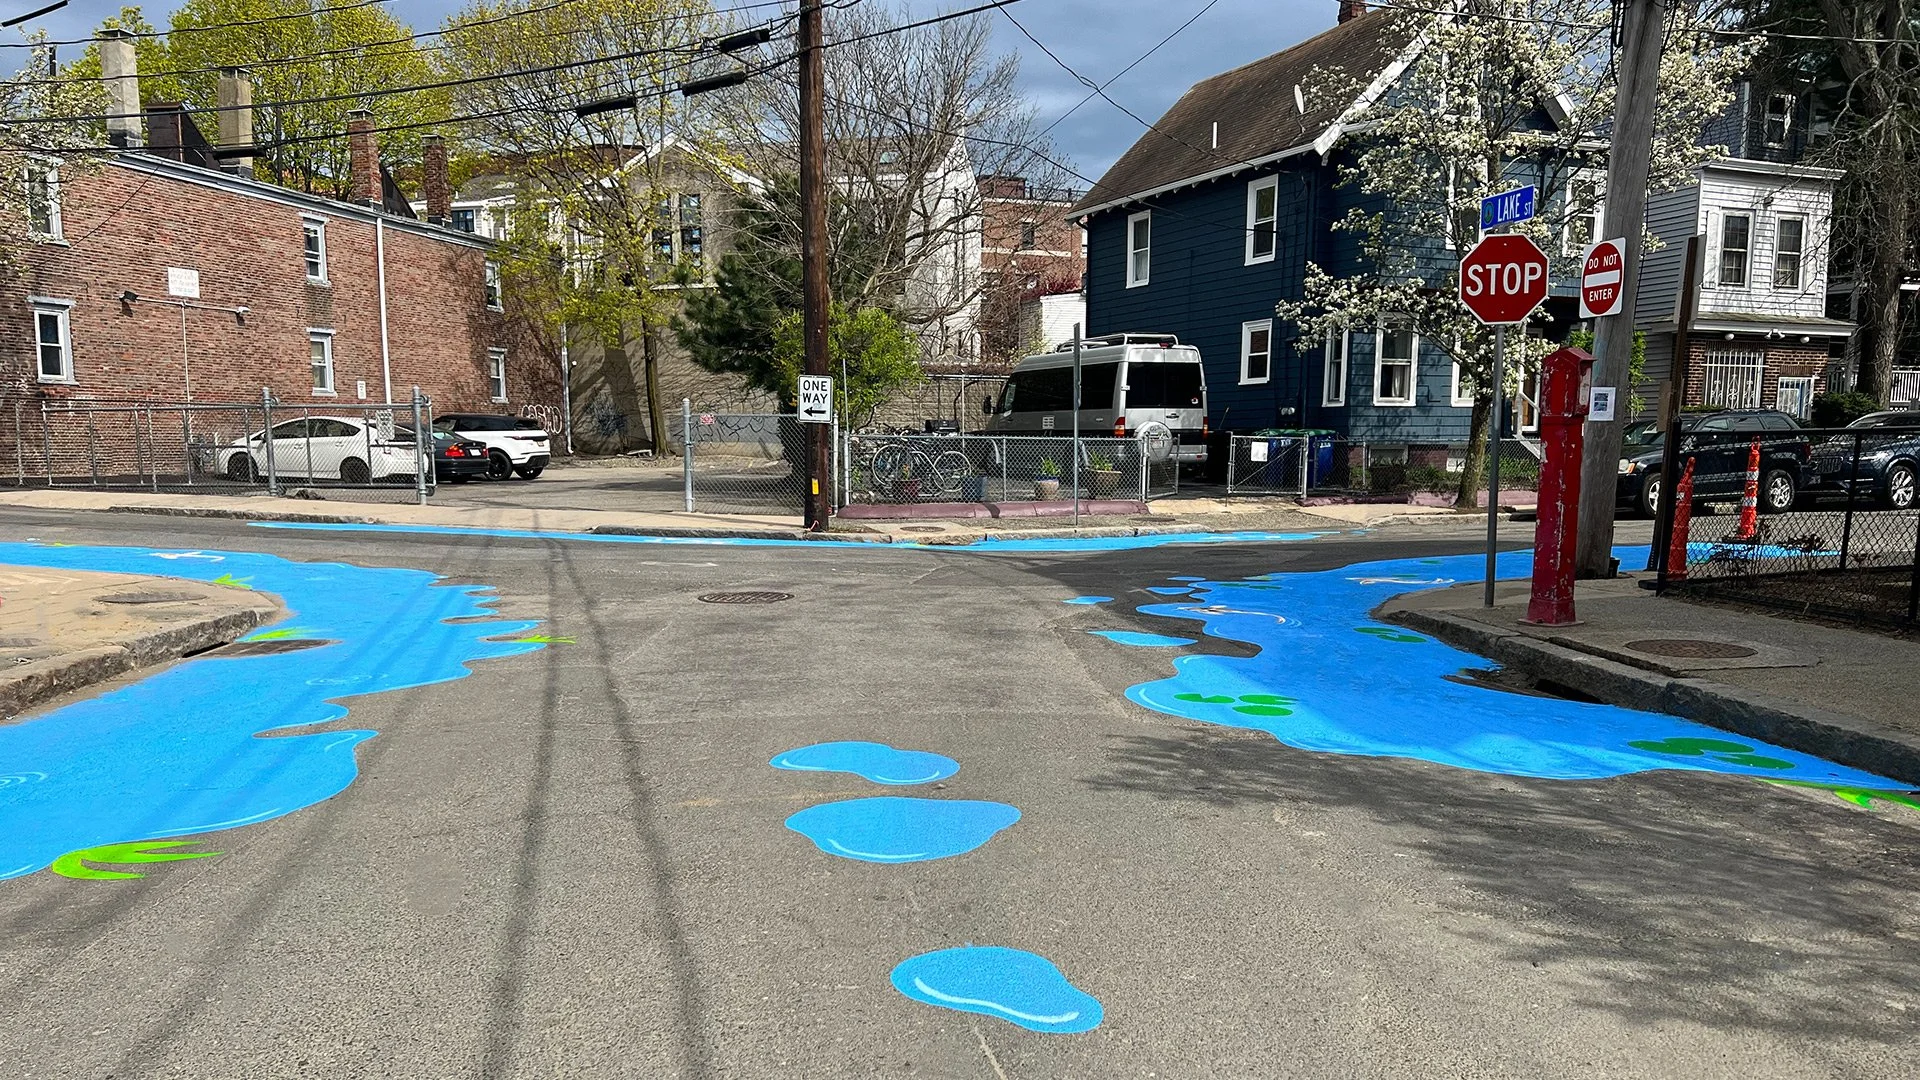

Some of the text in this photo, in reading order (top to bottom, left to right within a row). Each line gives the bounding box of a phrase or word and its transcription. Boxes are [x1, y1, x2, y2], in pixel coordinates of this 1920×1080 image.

[1498, 193, 1531, 222] LAKE ST
[1589, 253, 1618, 270] DO NOT
[1465, 262, 1542, 297] STOP
[1589, 288, 1613, 302] ENTER
[803, 380, 827, 391] ONE
[802, 393, 828, 404] WAY
